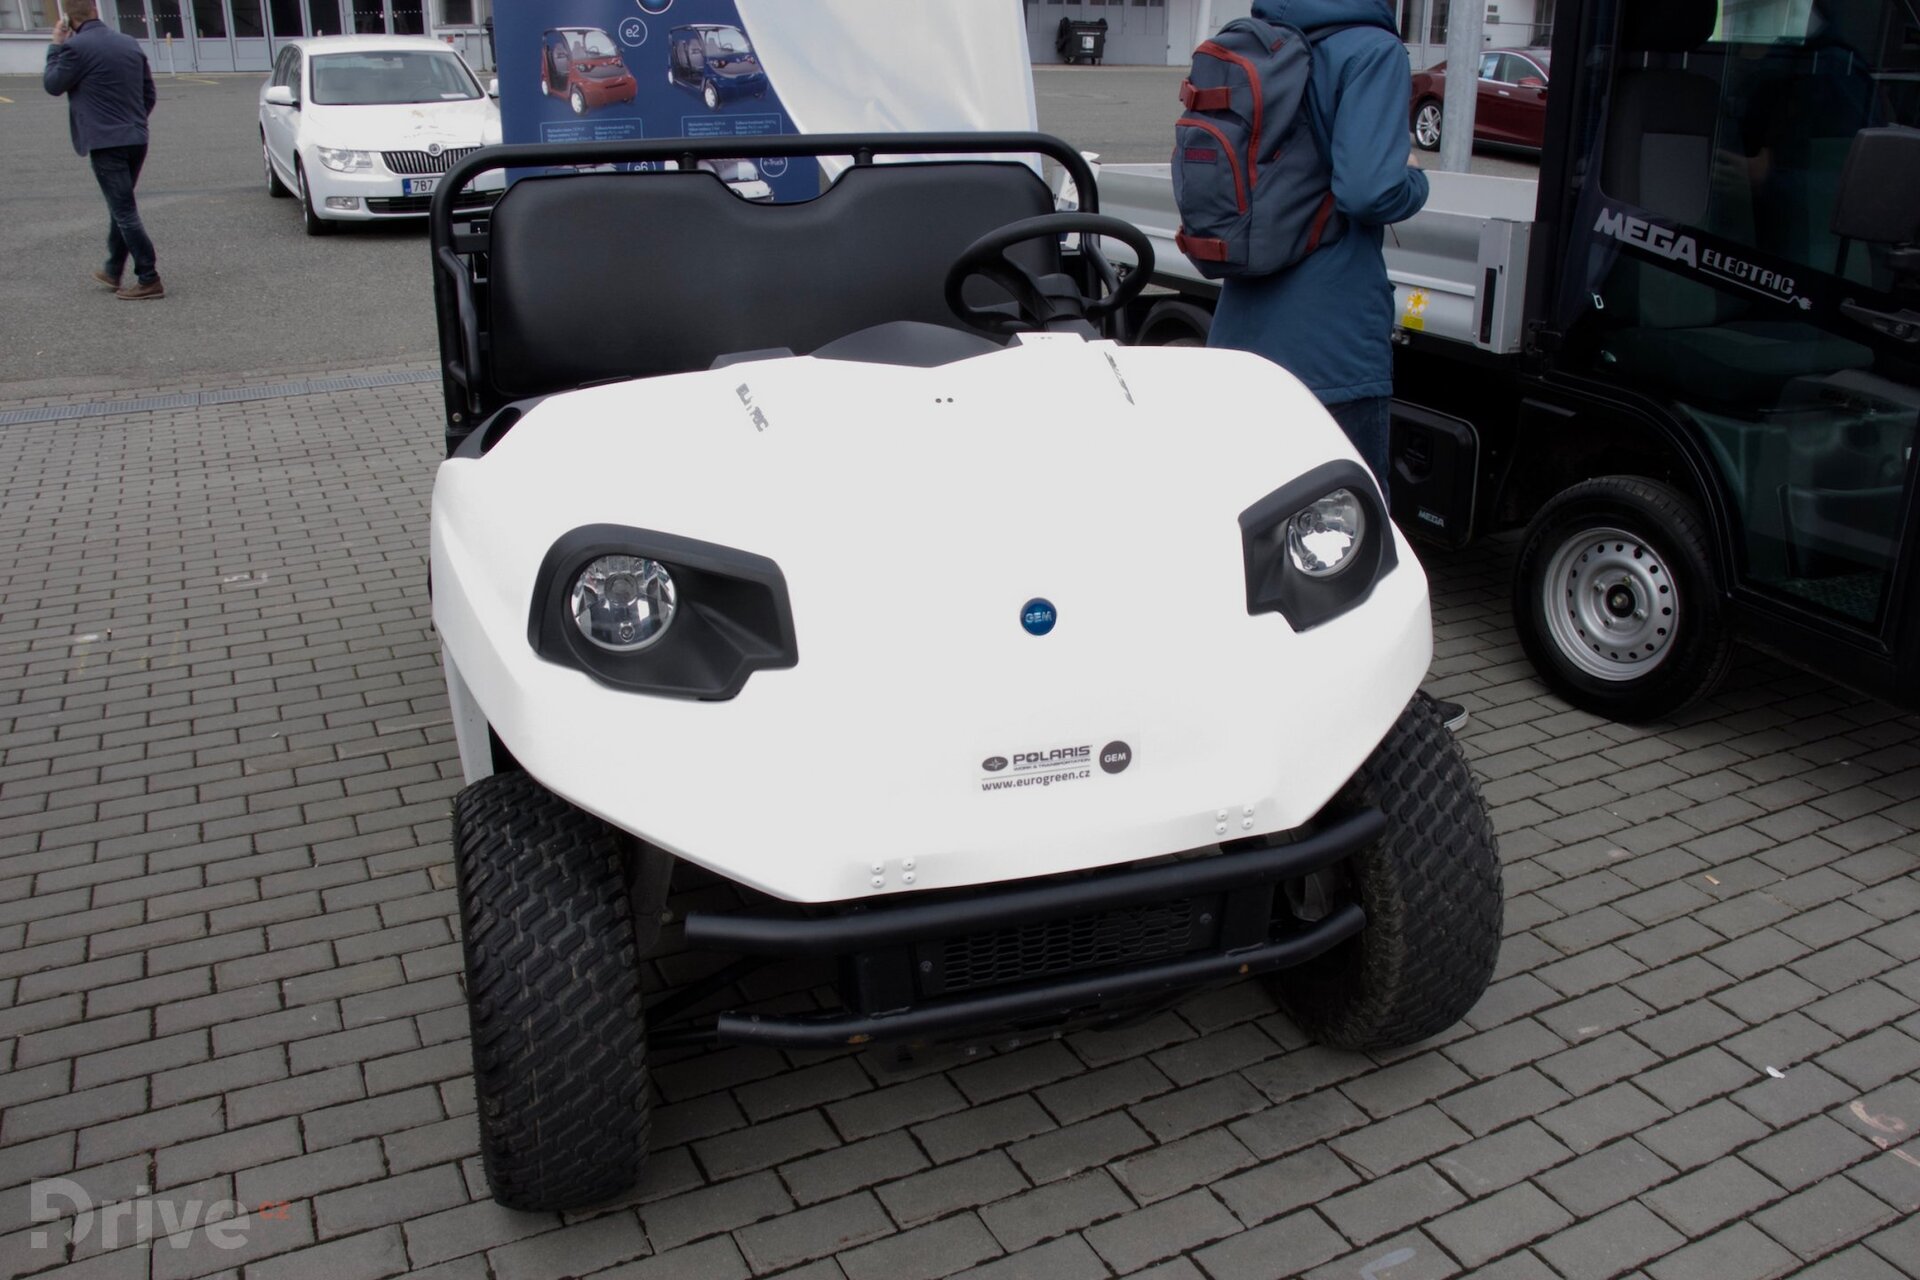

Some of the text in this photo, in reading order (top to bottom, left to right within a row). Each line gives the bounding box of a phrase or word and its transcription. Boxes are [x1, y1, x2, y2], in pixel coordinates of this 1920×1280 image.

[625, 24, 640, 38] e2
[1593, 207, 1795, 294] MEGA ELECTRIC
[1025, 610, 1052, 624] GEM
[1013, 745, 1091, 765] POLARIS
[1104, 752, 1127, 764] GEM
[981, 768, 1091, 792] www.eurogreen.cz
